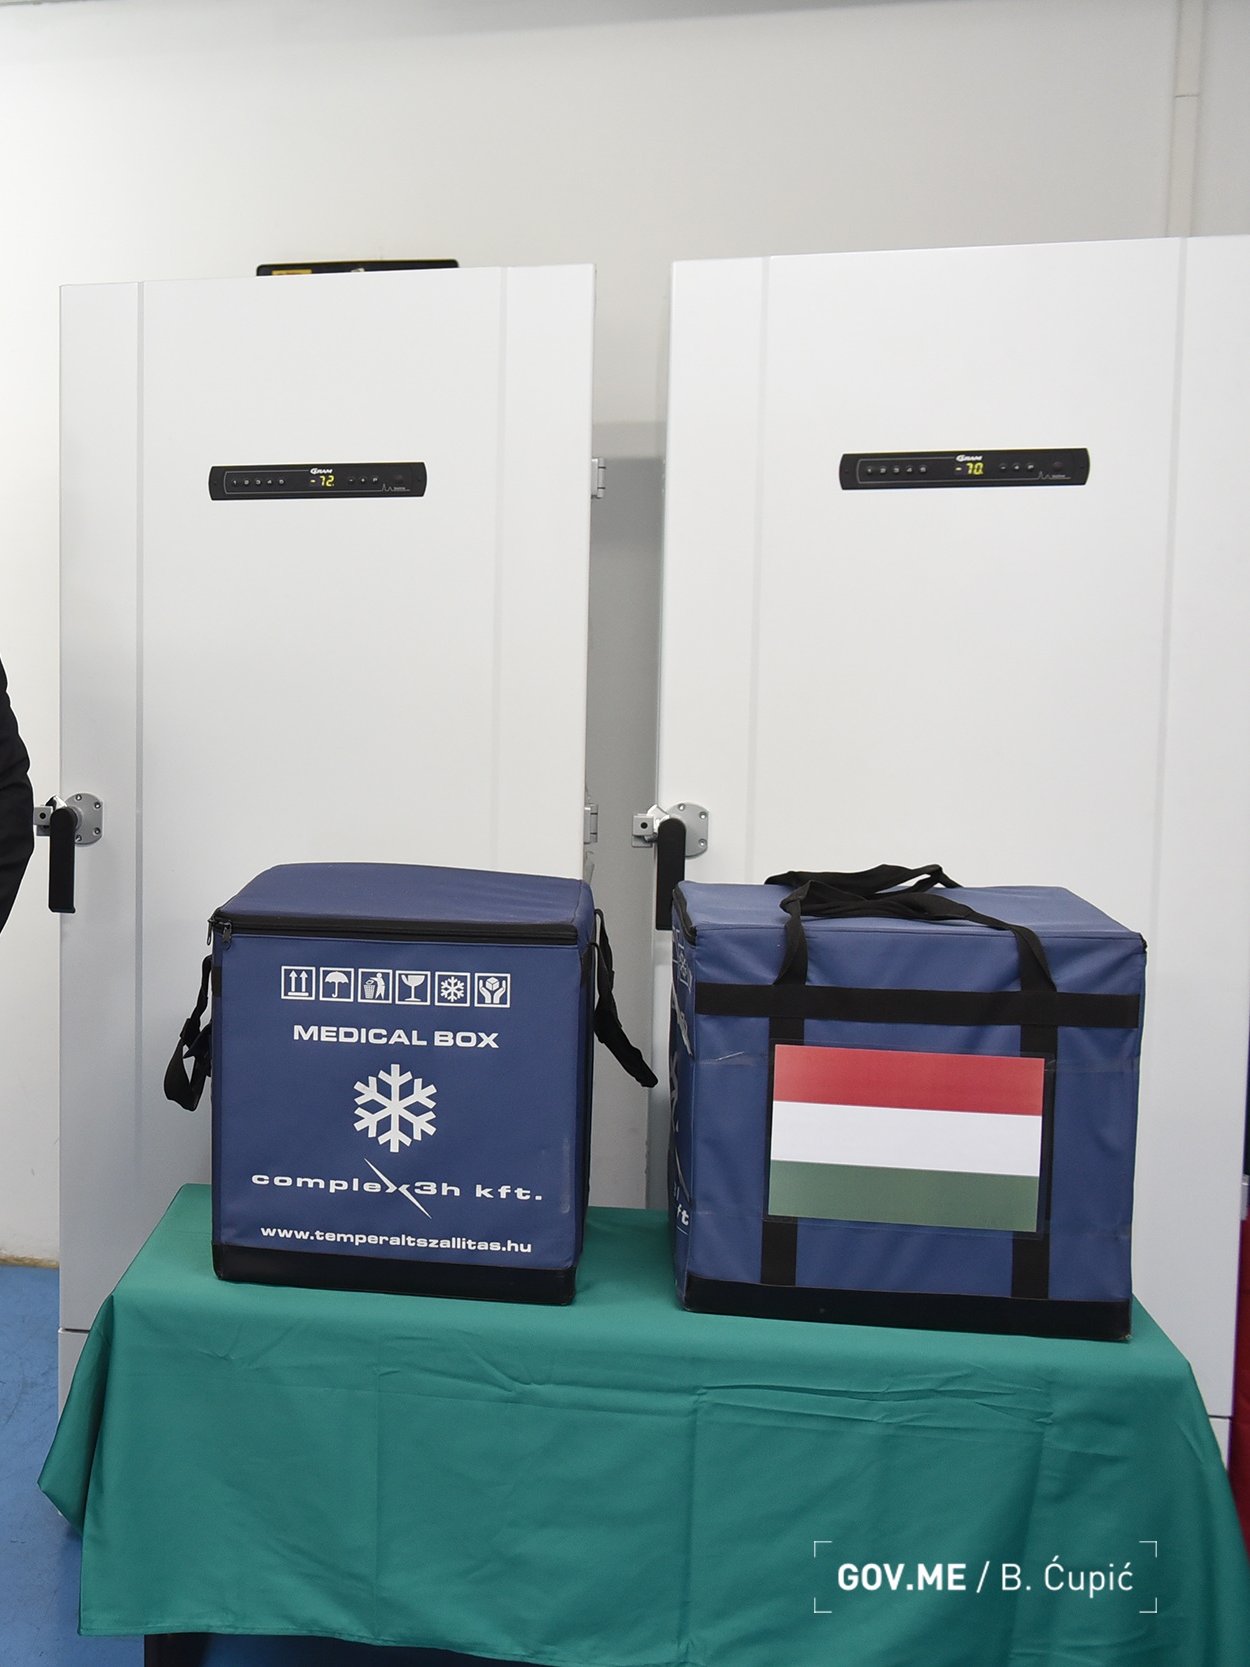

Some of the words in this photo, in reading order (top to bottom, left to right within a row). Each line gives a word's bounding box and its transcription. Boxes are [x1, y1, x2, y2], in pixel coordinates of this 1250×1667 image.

[293, 1024, 428, 1046] MEDICAL
[433, 1030, 500, 1049] BOX
[475, 1184, 543, 1201] kft.
[260, 1227, 533, 1254] www.temperaltszallitas.hu
